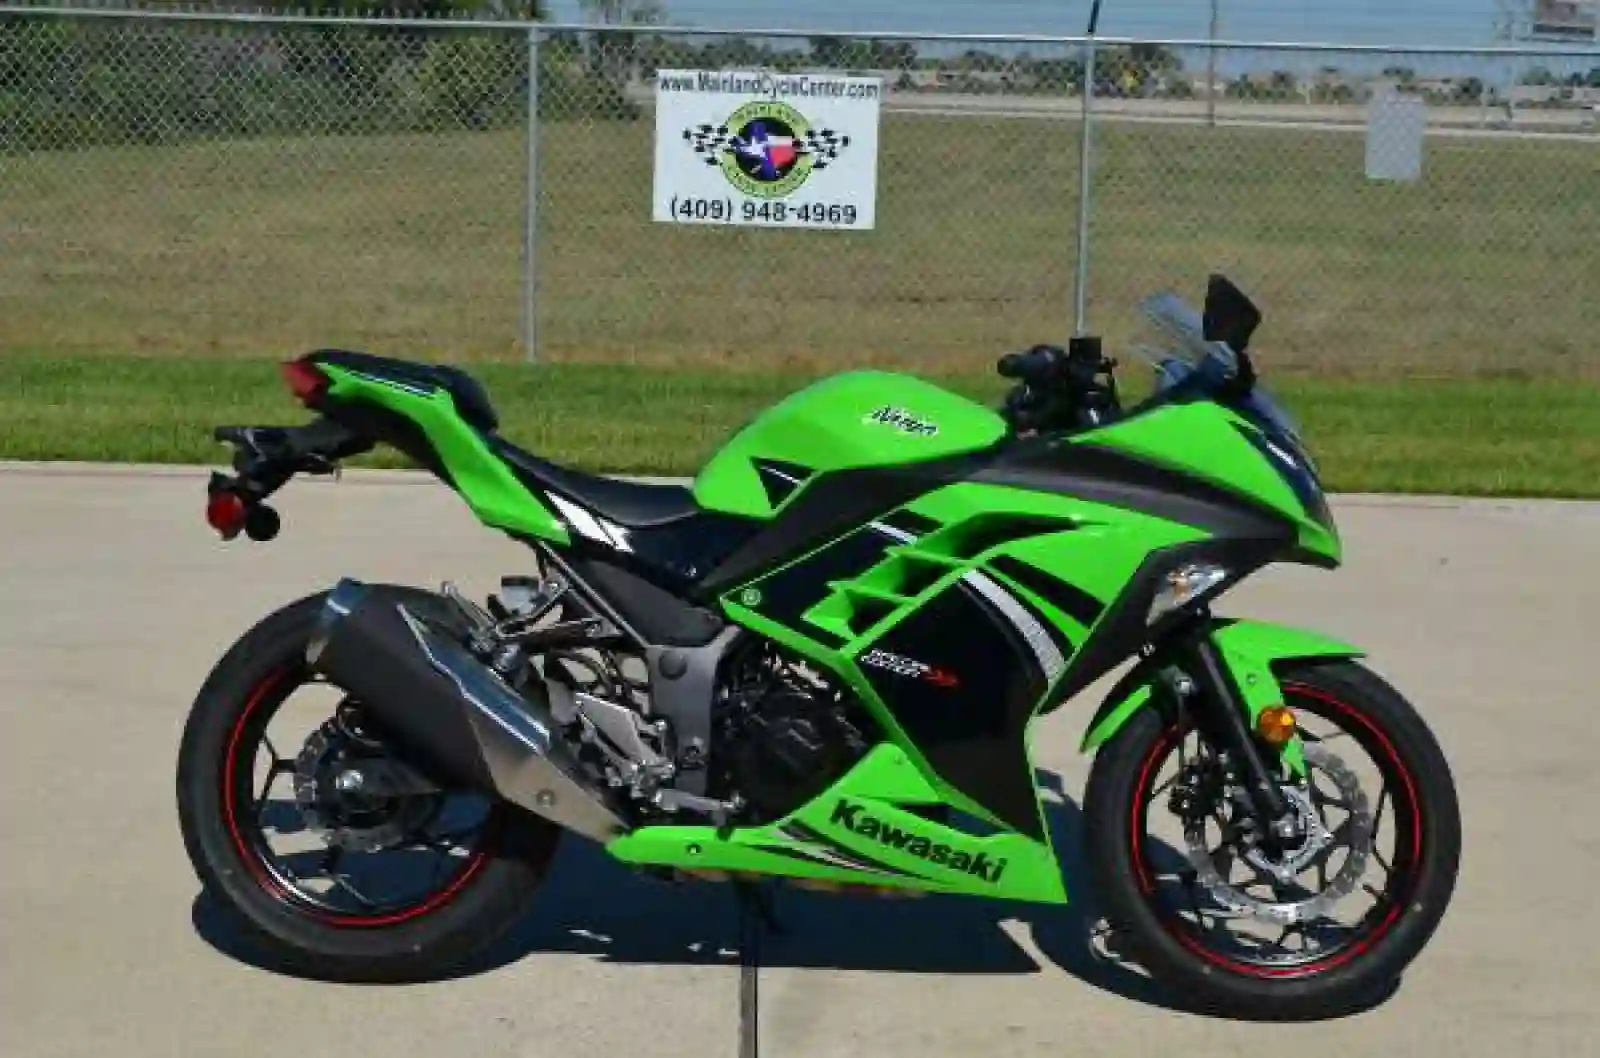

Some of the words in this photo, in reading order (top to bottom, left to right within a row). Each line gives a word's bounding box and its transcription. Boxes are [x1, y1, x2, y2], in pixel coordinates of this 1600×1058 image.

[671, 195, 732, 221] (409)
[742, 201, 857, 225] 948-4969
[830, 799, 1008, 883] Kawasaki
